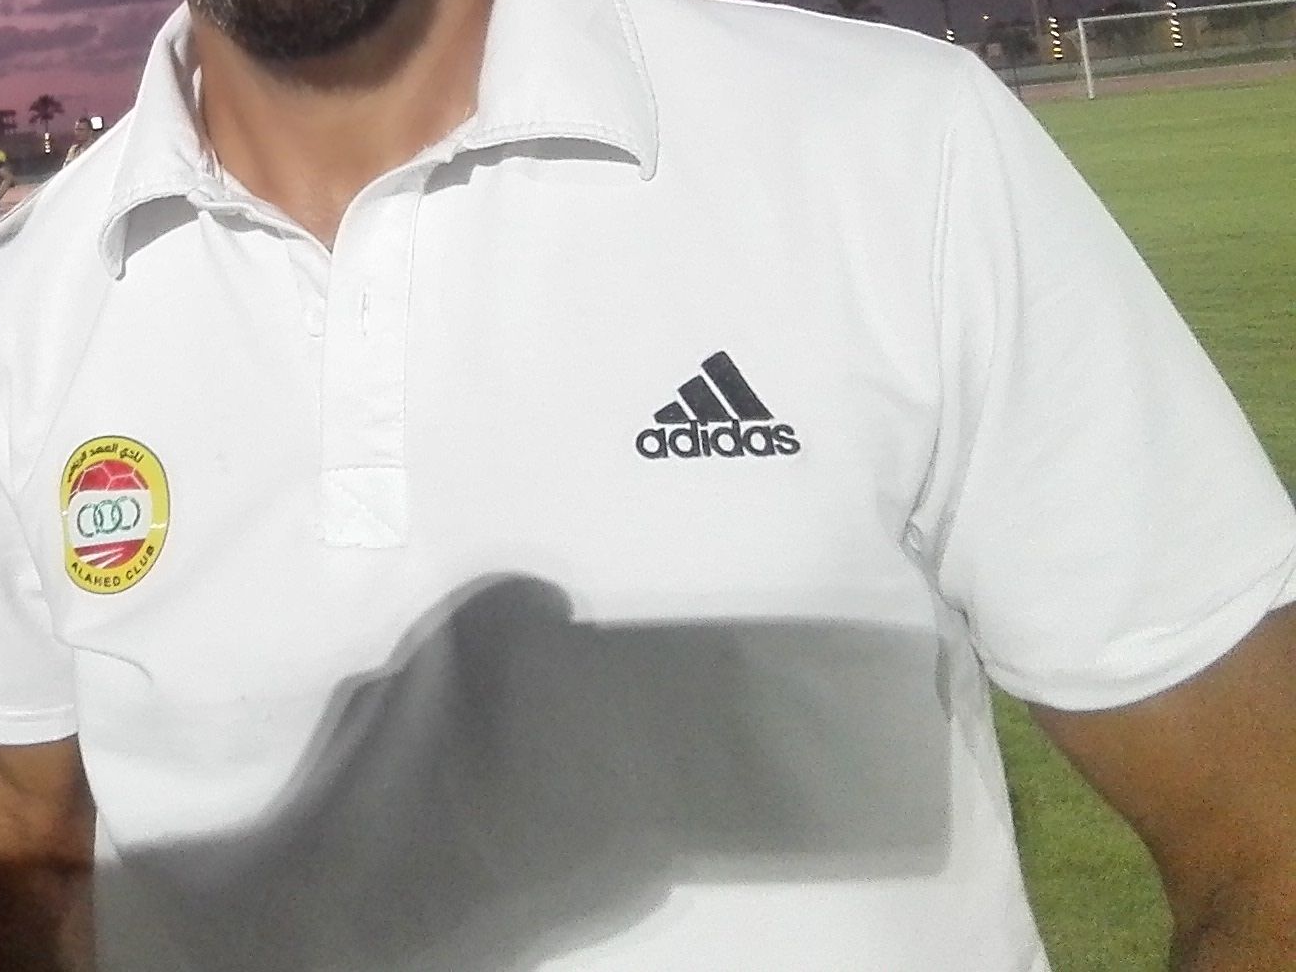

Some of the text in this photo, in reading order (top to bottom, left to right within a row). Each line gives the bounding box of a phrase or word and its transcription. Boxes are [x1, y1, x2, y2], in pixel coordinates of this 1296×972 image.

[636, 419, 801, 459] adidas
[71, 545, 155, 588] ALAHED CLUB
